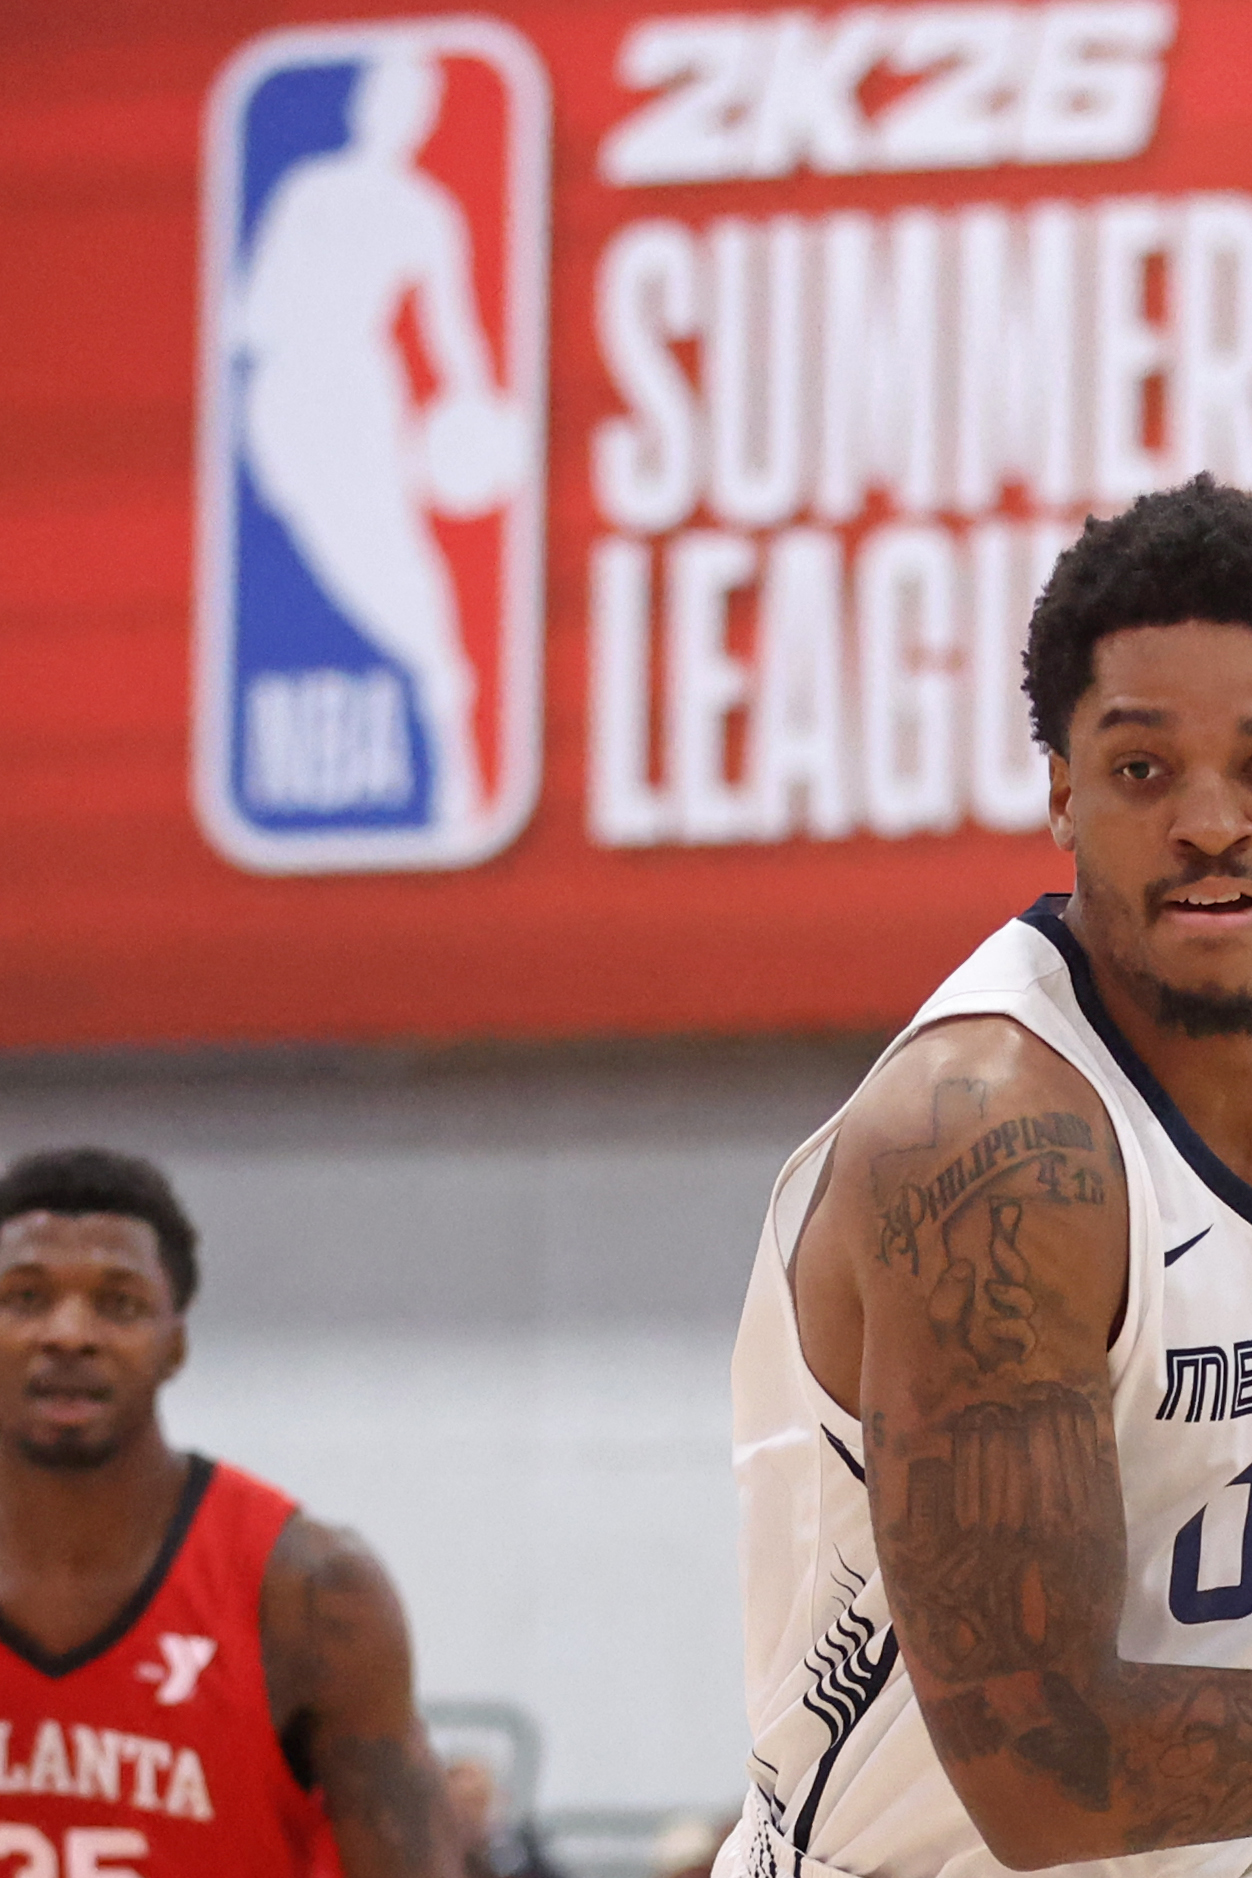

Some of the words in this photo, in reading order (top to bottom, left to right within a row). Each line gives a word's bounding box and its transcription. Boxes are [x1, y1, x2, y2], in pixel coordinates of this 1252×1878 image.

[600, 2, 1178, 186] 2K26
[247, 672, 412, 808] NBA
[586, 520, 1076, 850] LEAGU
[0, 1718, 214, 1823] LANTA
